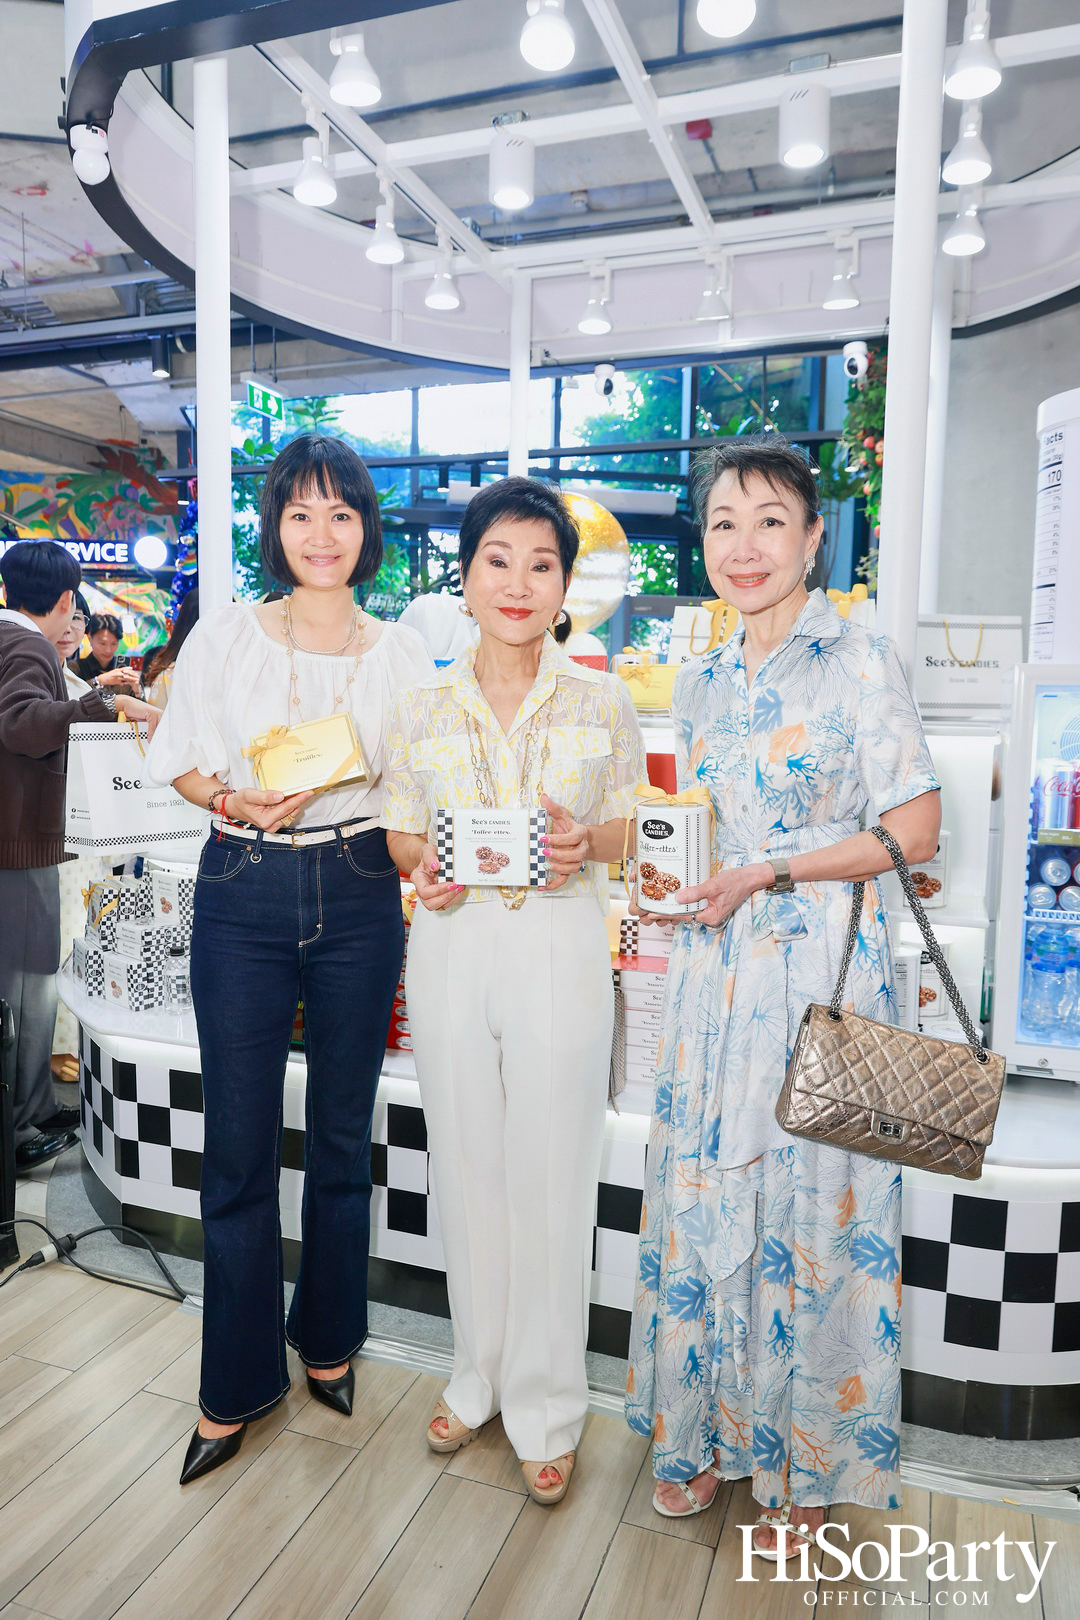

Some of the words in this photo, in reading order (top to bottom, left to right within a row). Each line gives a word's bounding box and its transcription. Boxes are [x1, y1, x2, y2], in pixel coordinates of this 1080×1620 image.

[1048, 469, 1061, 484] 170
[58, 541, 128, 563] RVICE
[925, 656, 956, 667] See's
[112, 776, 143, 791] See
[146, 801, 168, 809] Since
[169, 799, 186, 807] 1921
[647, 820, 666, 831] See's
